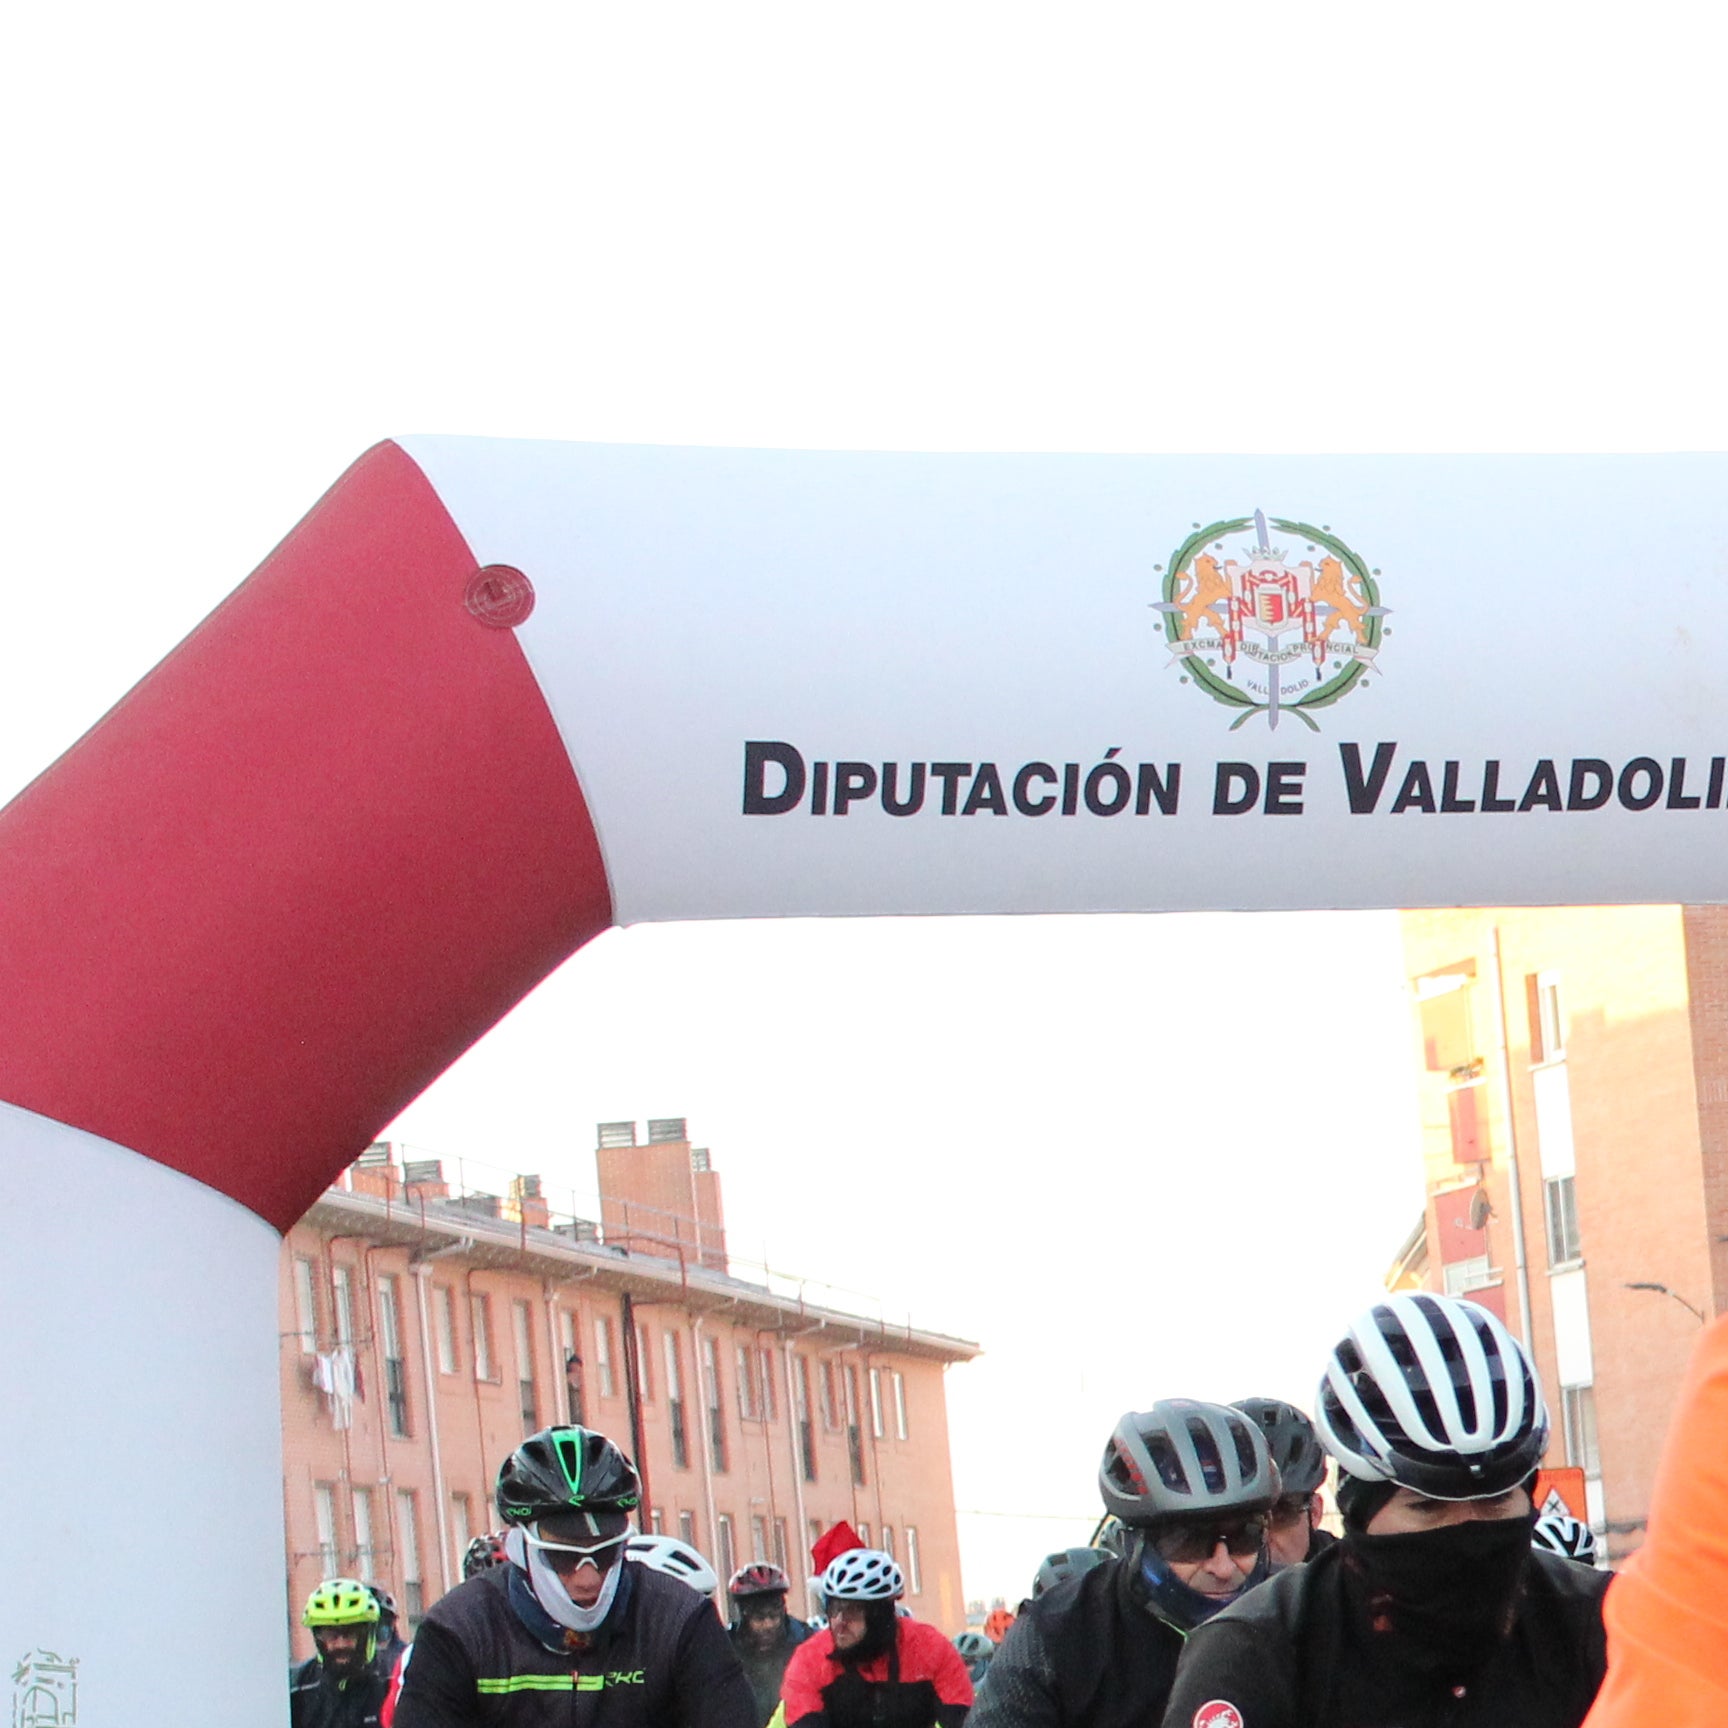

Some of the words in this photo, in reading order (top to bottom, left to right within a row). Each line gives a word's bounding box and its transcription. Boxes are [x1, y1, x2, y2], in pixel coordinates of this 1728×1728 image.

[1247, 679, 1310, 696] VALLDOLID
[742, 740, 1181, 817] DIPUTACIÓN
[1212, 760, 1309, 817] DE
